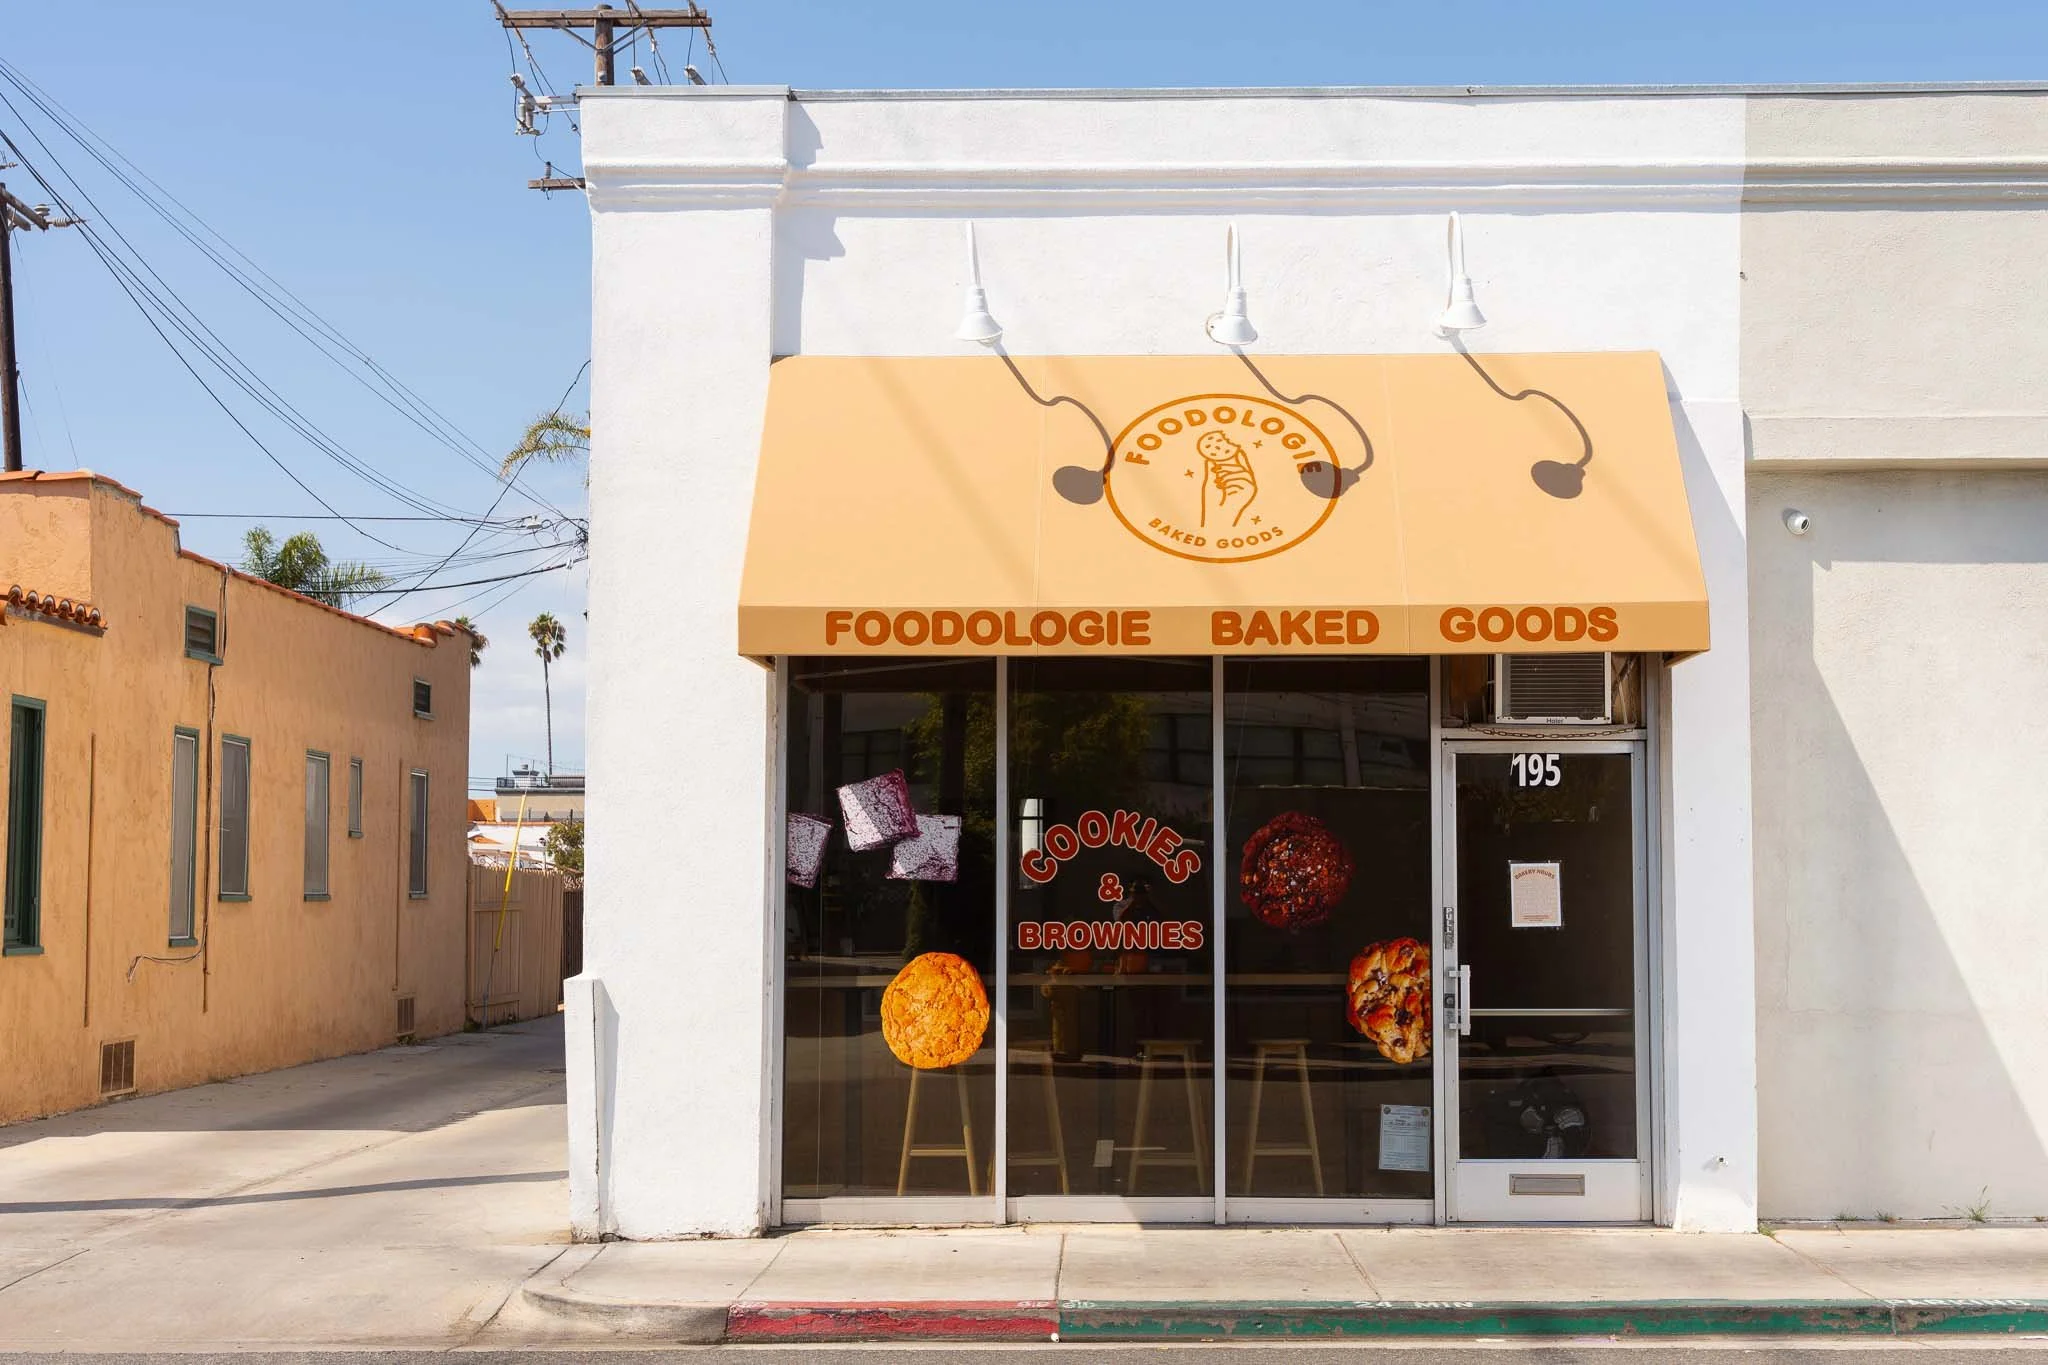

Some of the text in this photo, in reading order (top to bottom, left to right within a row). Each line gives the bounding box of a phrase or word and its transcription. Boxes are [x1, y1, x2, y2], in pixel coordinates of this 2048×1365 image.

[1124, 405, 1322, 475] FOODOLOGIE
[1148, 516, 1284, 549] BAKED GOODS
[825, 606, 1619, 647] FOODOLOGIE BAKED GOODS
[1512, 753, 1561, 787] 195
[1020, 809, 1201, 884] COOKIES
[1098, 872, 1124, 902] &
[1018, 920, 1204, 950] BROWNIES
[1413, 1300, 1474, 1308] MIN
